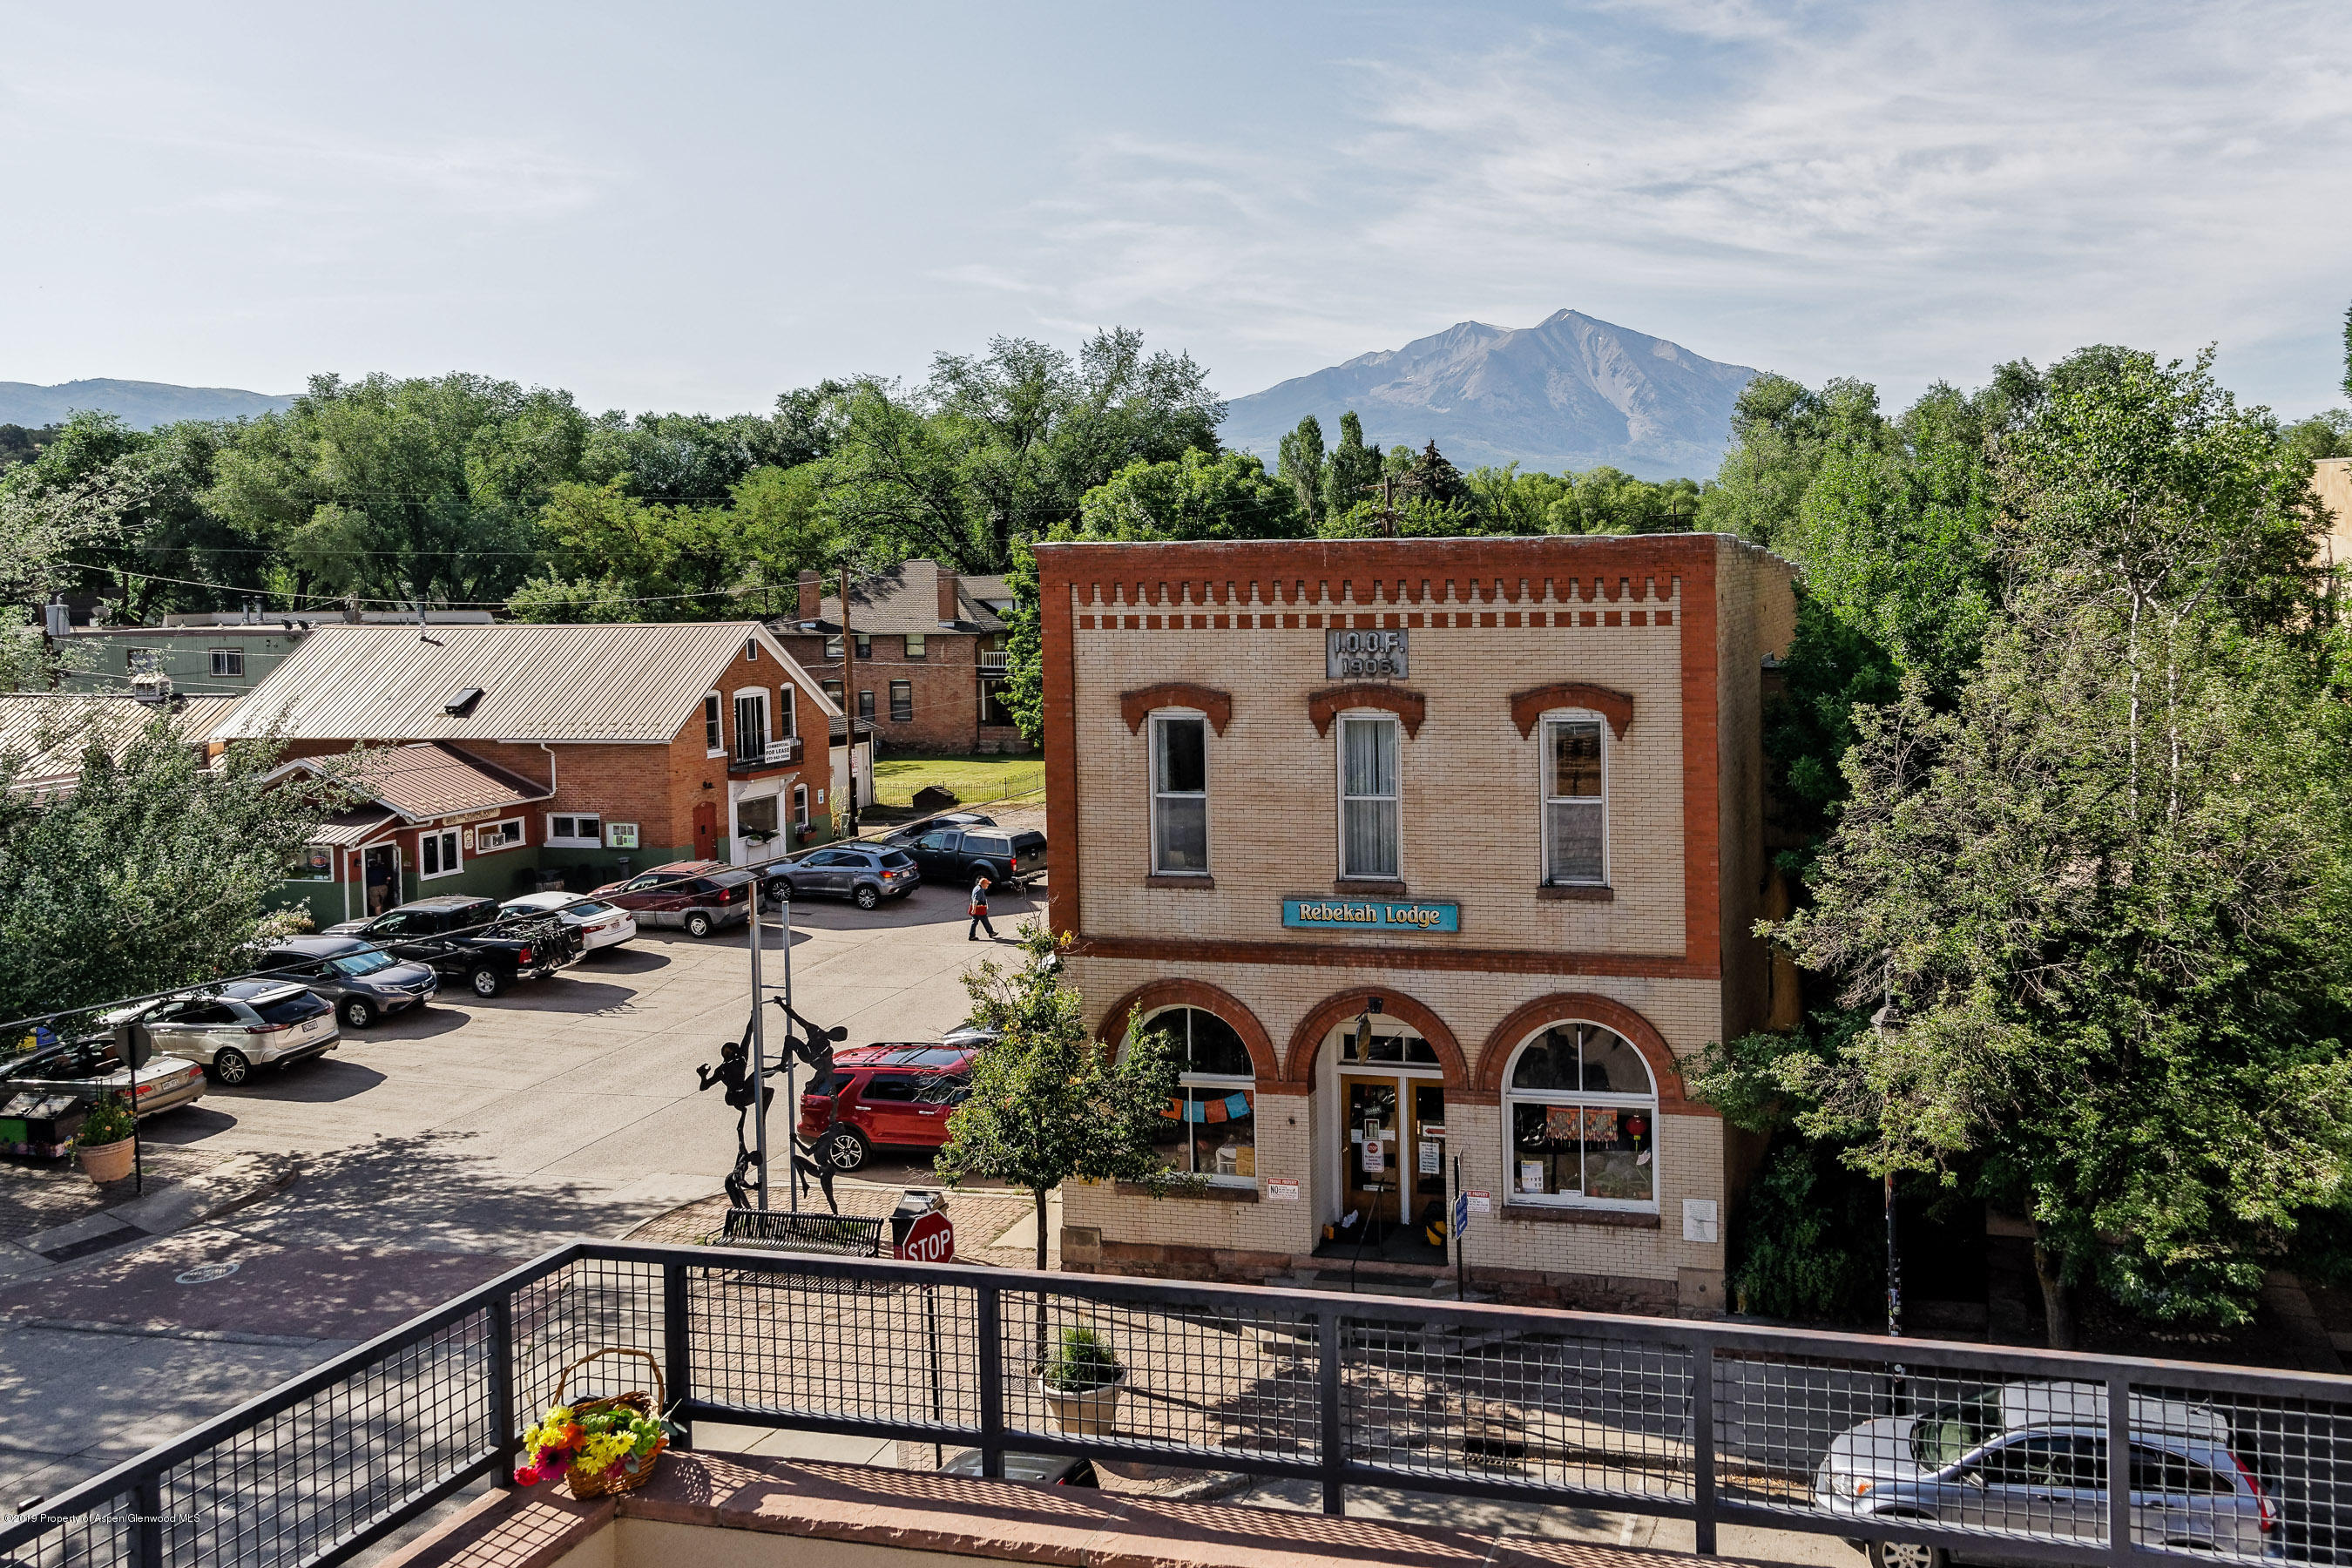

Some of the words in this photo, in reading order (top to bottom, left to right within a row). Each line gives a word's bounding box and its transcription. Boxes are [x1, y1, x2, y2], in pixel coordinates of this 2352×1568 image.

[1335, 632, 1405, 653] I.O.O.F.
[1299, 902, 1377, 923] Rebekah
[1385, 906, 1440, 928] Lodge
[1270, 1185, 1279, 1194] NO
[908, 1229, 950, 1262] STOP
